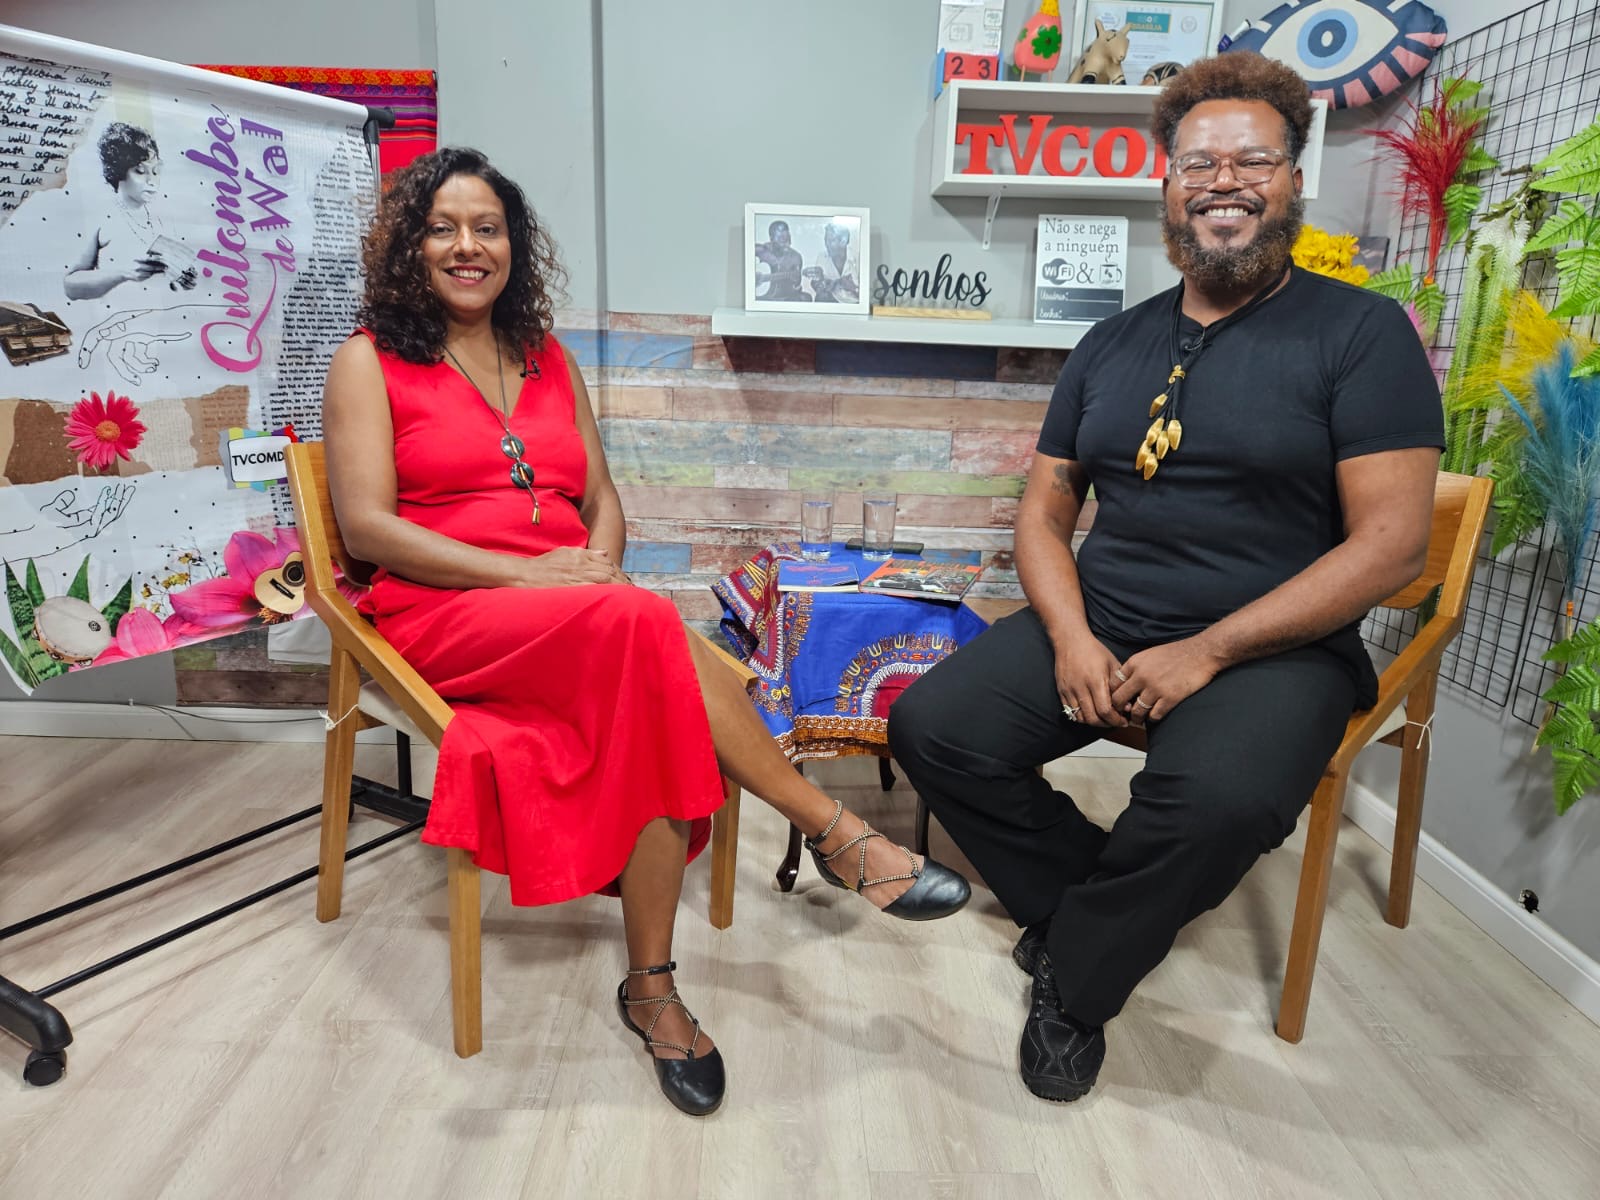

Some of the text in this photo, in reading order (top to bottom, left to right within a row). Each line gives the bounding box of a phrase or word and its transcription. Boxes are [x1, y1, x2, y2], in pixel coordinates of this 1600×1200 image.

[956, 114, 1167, 180] TVCO
[185, 103, 263, 373] Quilombo
[1044, 238, 1119, 257] a ninguém
[1045, 217, 1117, 240] Não se nega
[873, 253, 992, 307] sonhos
[232, 451, 285, 466] TVCOMD
